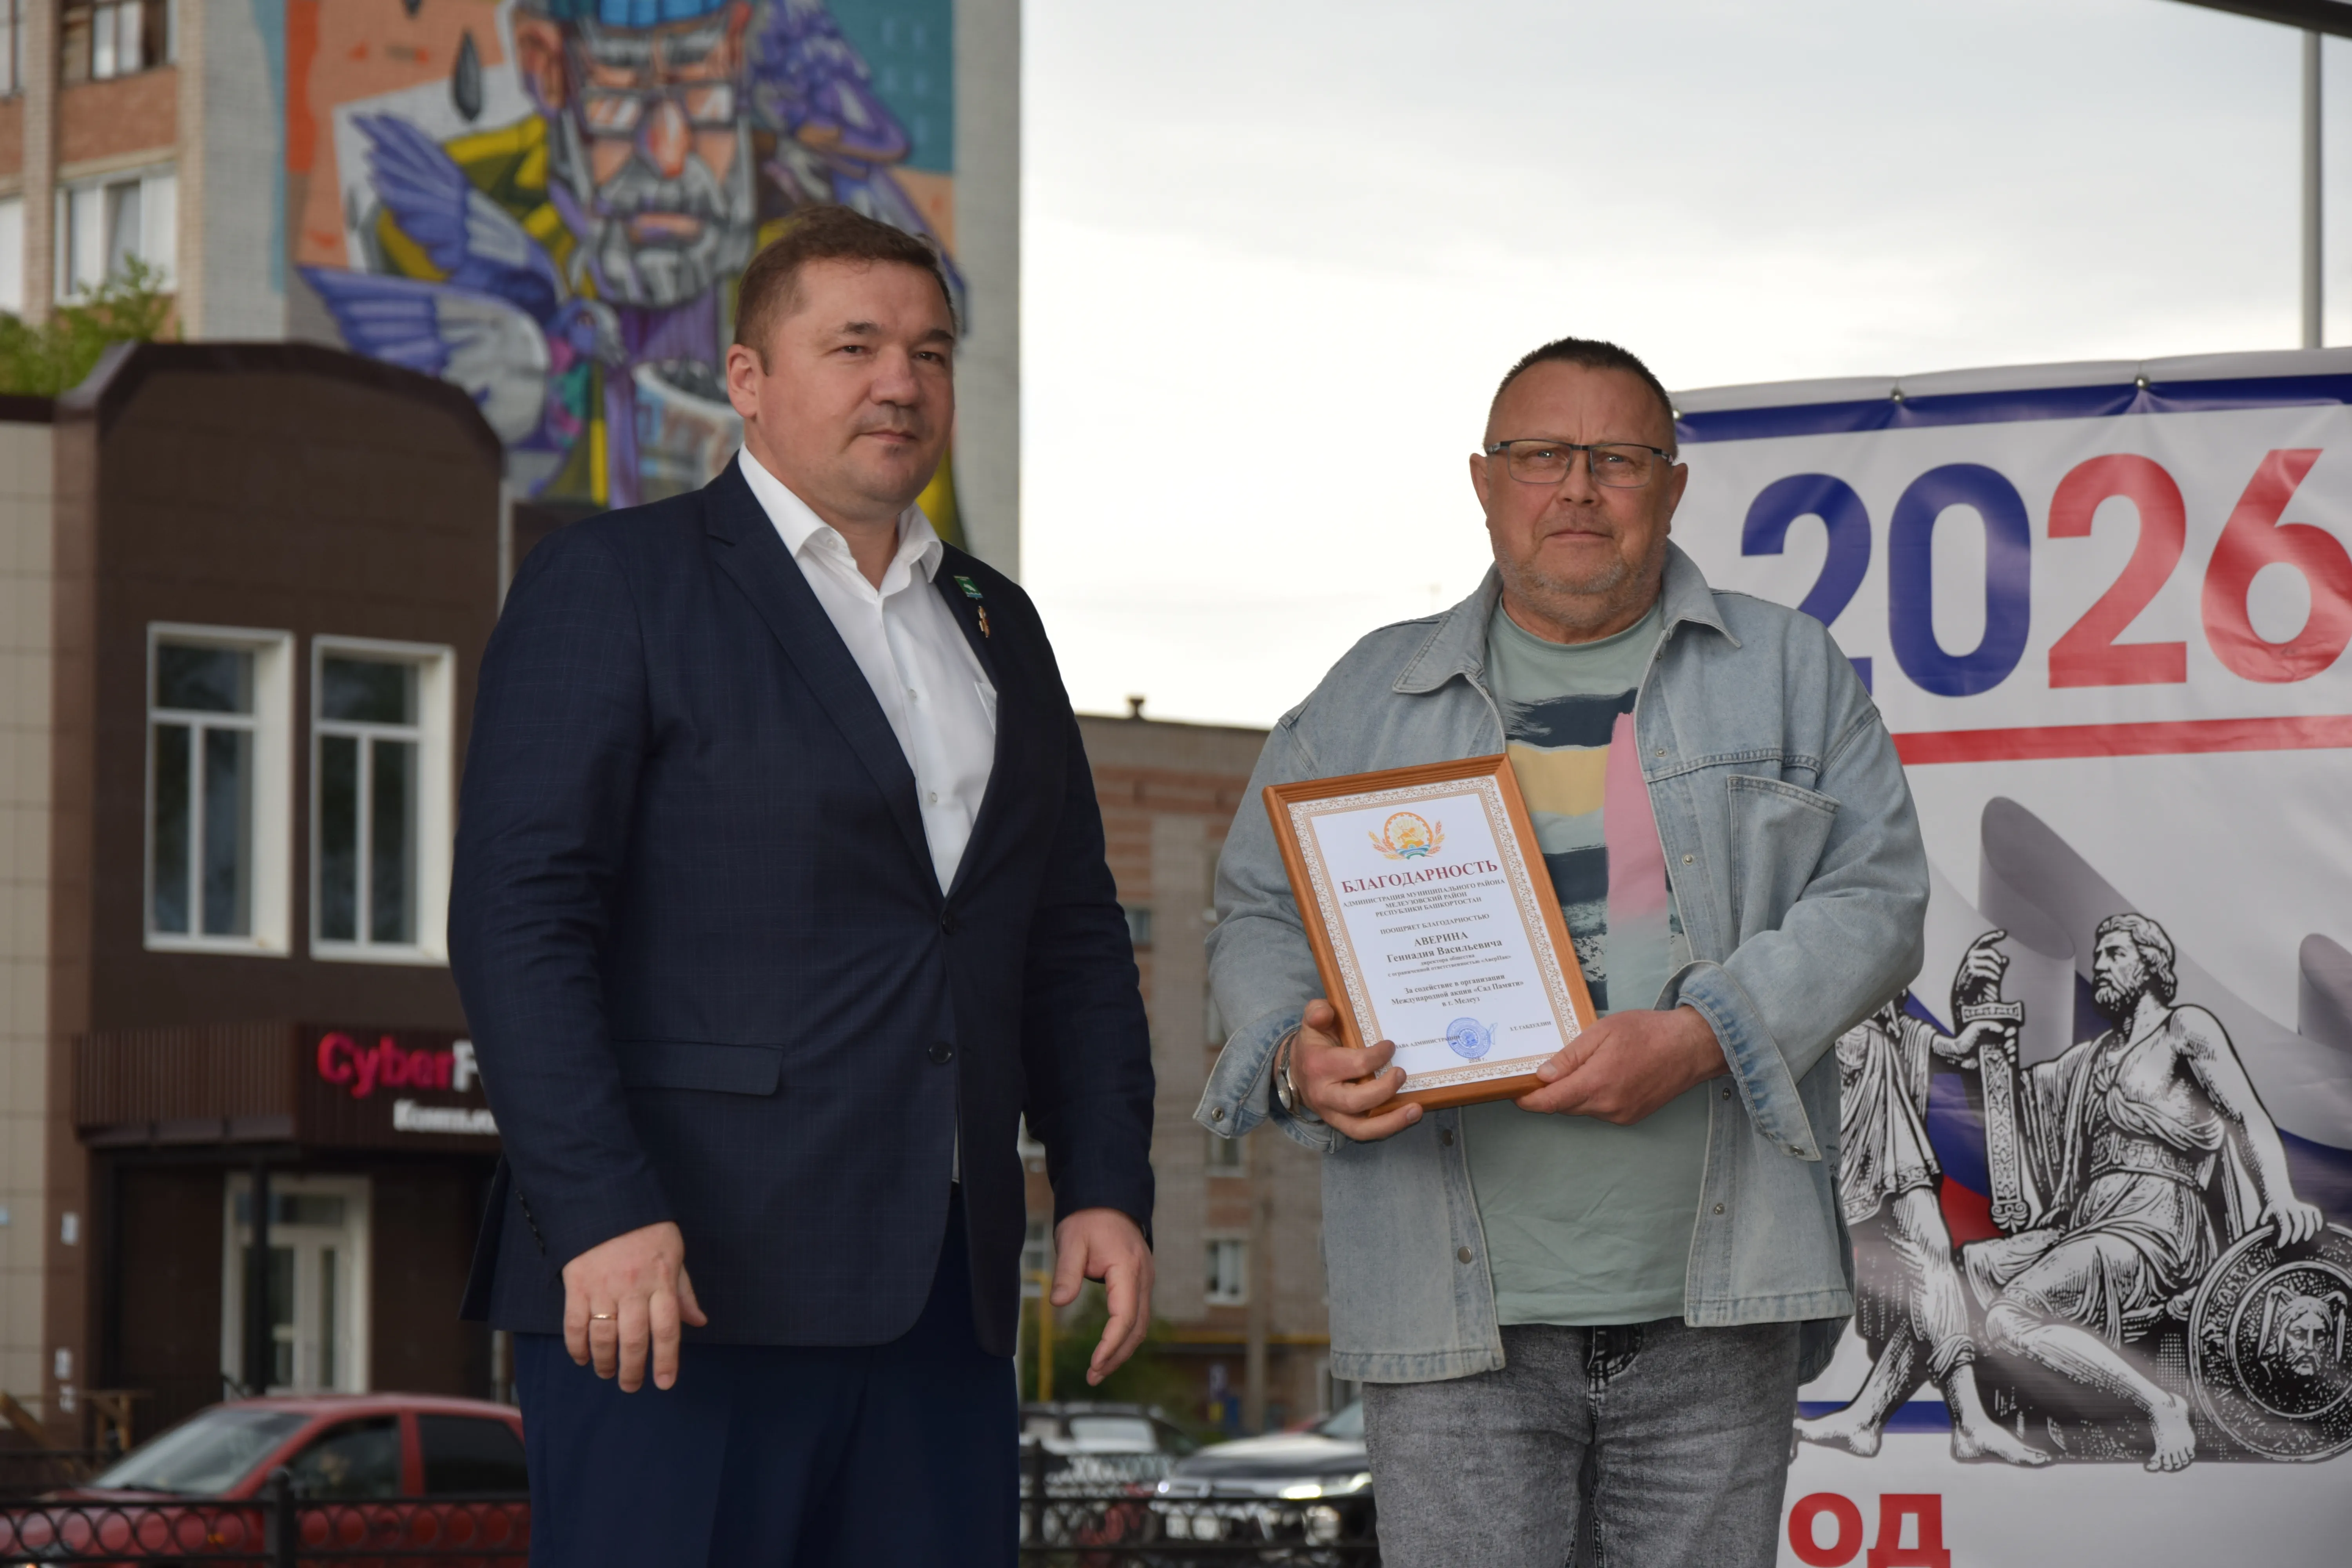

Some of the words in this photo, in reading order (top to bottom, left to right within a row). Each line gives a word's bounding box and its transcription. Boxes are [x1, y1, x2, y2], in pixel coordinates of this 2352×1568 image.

[1741, 448, 2352, 697] 2026
[1341, 860, 1498, 893] БЛАГОДАРНОСТЬ
[1343, 894, 1405, 907] АДМИНИСТРАЦИЯ
[1406, 883, 1476, 898] МУНИЦИПАЛЬНОГО
[1477, 879, 1505, 887] РАЙОНА
[1385, 894, 1443, 908] МЕЛЕУЗОВСКИЙ
[1444, 891, 1467, 900] РАЙОН
[1376, 906, 1422, 917] РЕСПУБЛИКИ
[1424, 897, 1482, 910] БАШКОРТОСТАН
[1380, 924, 1420, 935] ПООЩРЯЕТ
[1421, 914, 1490, 928] БЛАГОДАРНОСТЬЮ
[1414, 931, 1468, 947] АВЕРИНА
[1386, 950, 1434, 963] Геннадия
[1437, 940, 1503, 955] Васильевича
[1391, 991, 1448, 1005] Международной
[1492, 981, 1524, 990] Памяти»
[1415, 983, 1453, 993] содействие
[1461, 975, 1505, 987] организации
[1454, 996, 1480, 1005] Мелеуз
[1781, 1492, 1951, 1568] ОД
